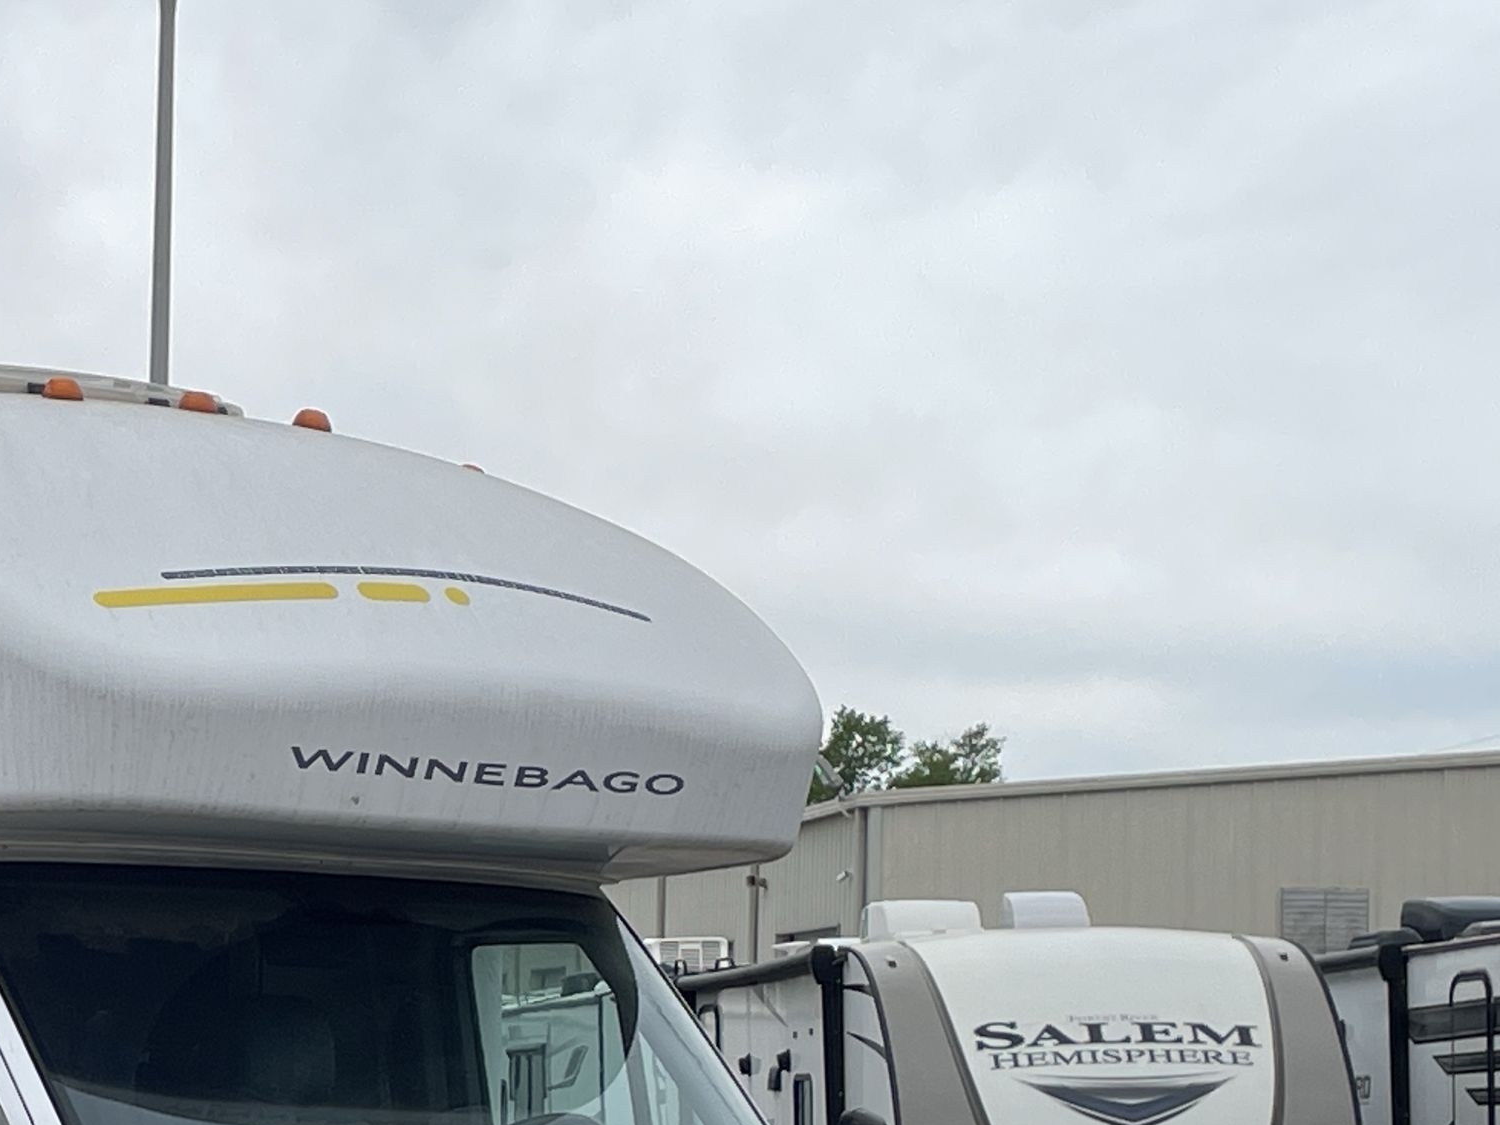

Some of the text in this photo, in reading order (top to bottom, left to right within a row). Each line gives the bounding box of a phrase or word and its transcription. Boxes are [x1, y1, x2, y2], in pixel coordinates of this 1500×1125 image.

[291, 746, 685, 796] WINNEBAGO
[973, 1021, 1262, 1050] SALEM
[989, 1049, 1254, 1070] HEMISPHERE
